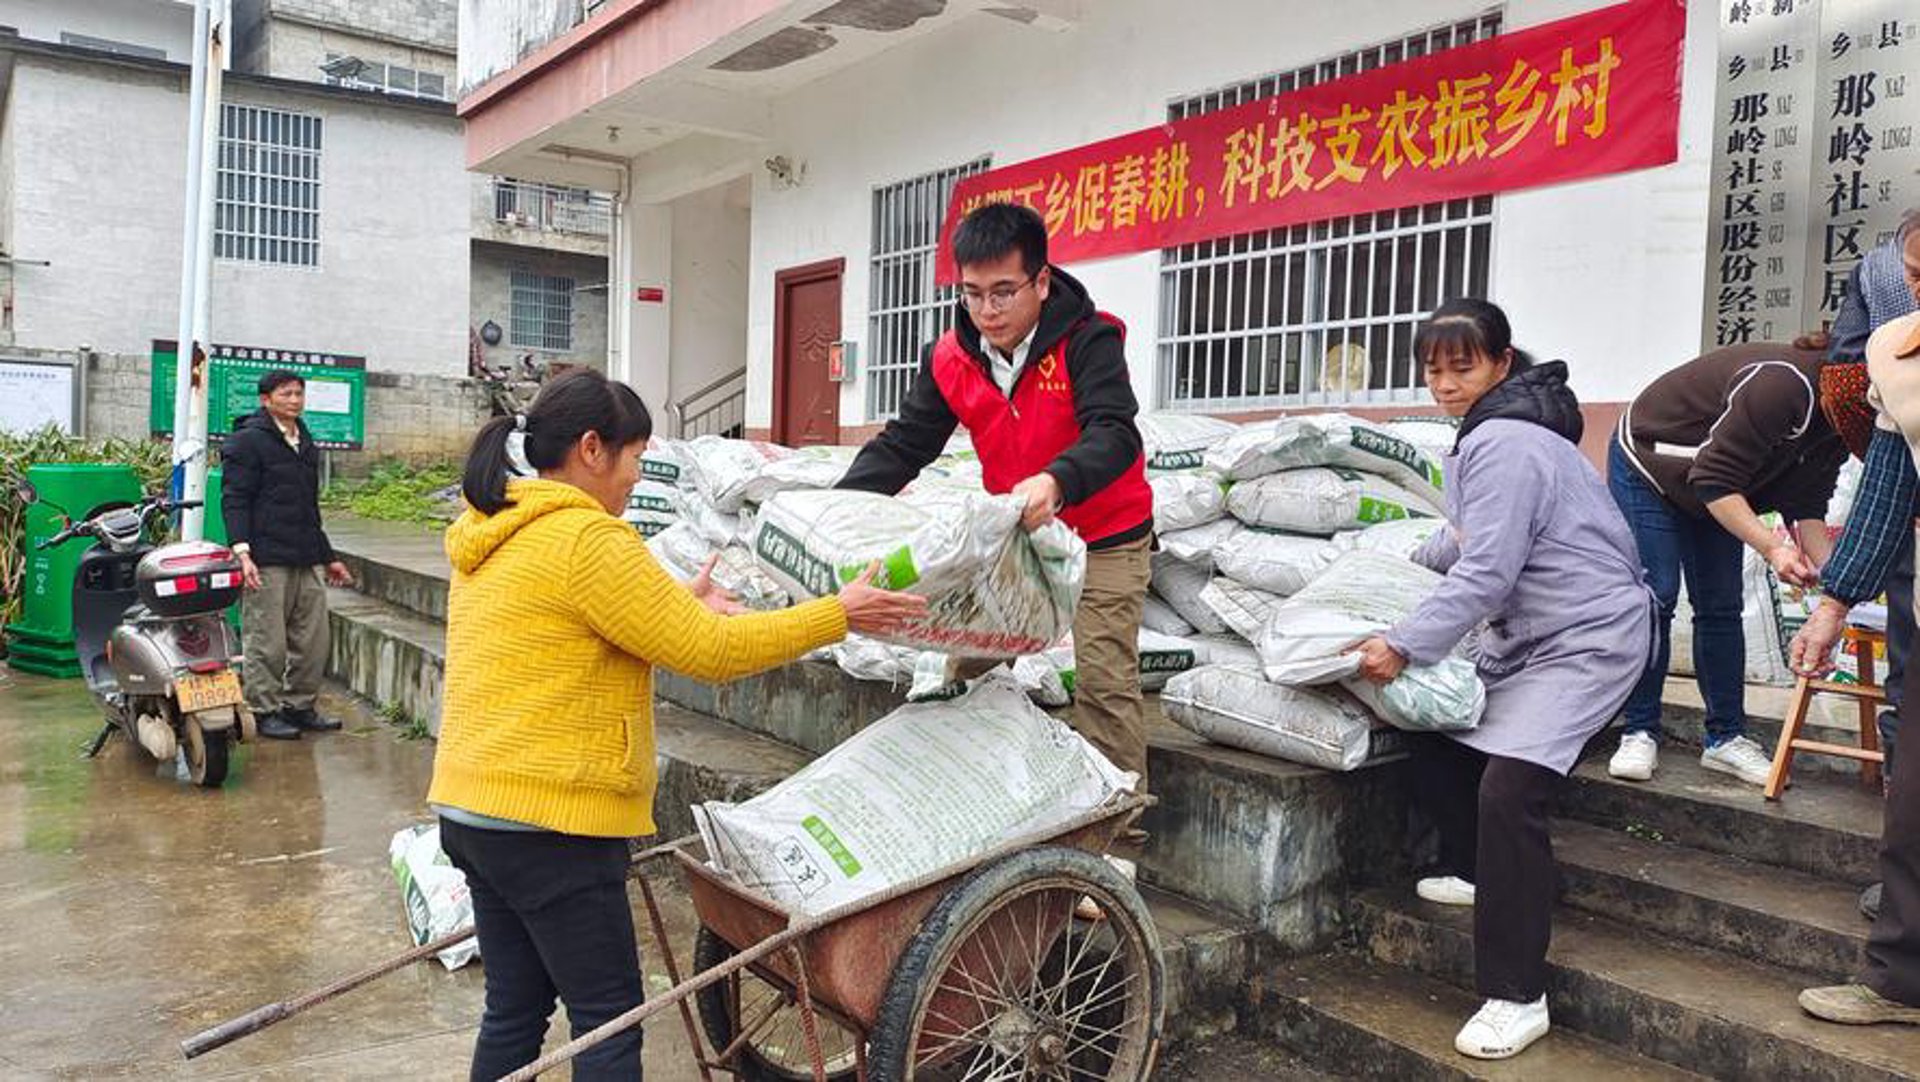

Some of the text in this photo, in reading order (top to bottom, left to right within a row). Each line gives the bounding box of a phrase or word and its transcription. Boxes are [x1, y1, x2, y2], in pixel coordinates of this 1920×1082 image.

[961, 38, 1623, 239] 下乡促春耕，科技支农振乡村
[1717, 92, 1769, 346] 那岭社区股份经济
[1820, 71, 1878, 331] 那岭社区居
